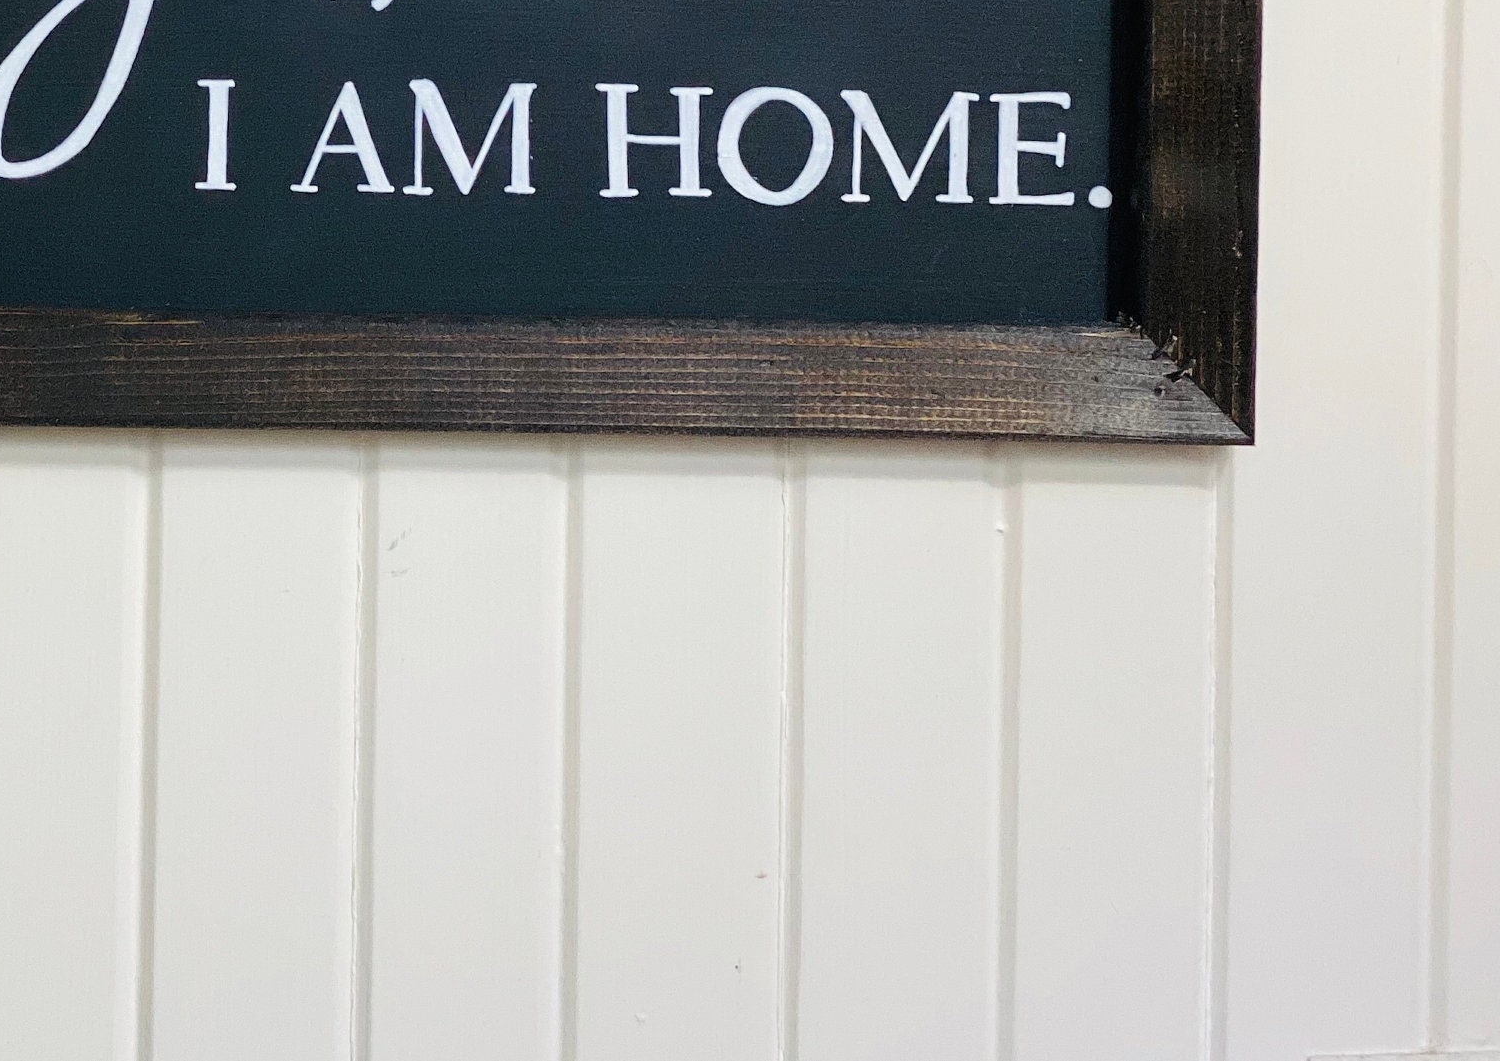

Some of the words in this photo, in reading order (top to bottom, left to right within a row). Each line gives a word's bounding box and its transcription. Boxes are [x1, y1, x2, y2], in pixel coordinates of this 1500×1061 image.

[194, 79, 237, 191] I
[290, 78, 538, 196] AM
[594, 83, 1113, 209] HOME.
